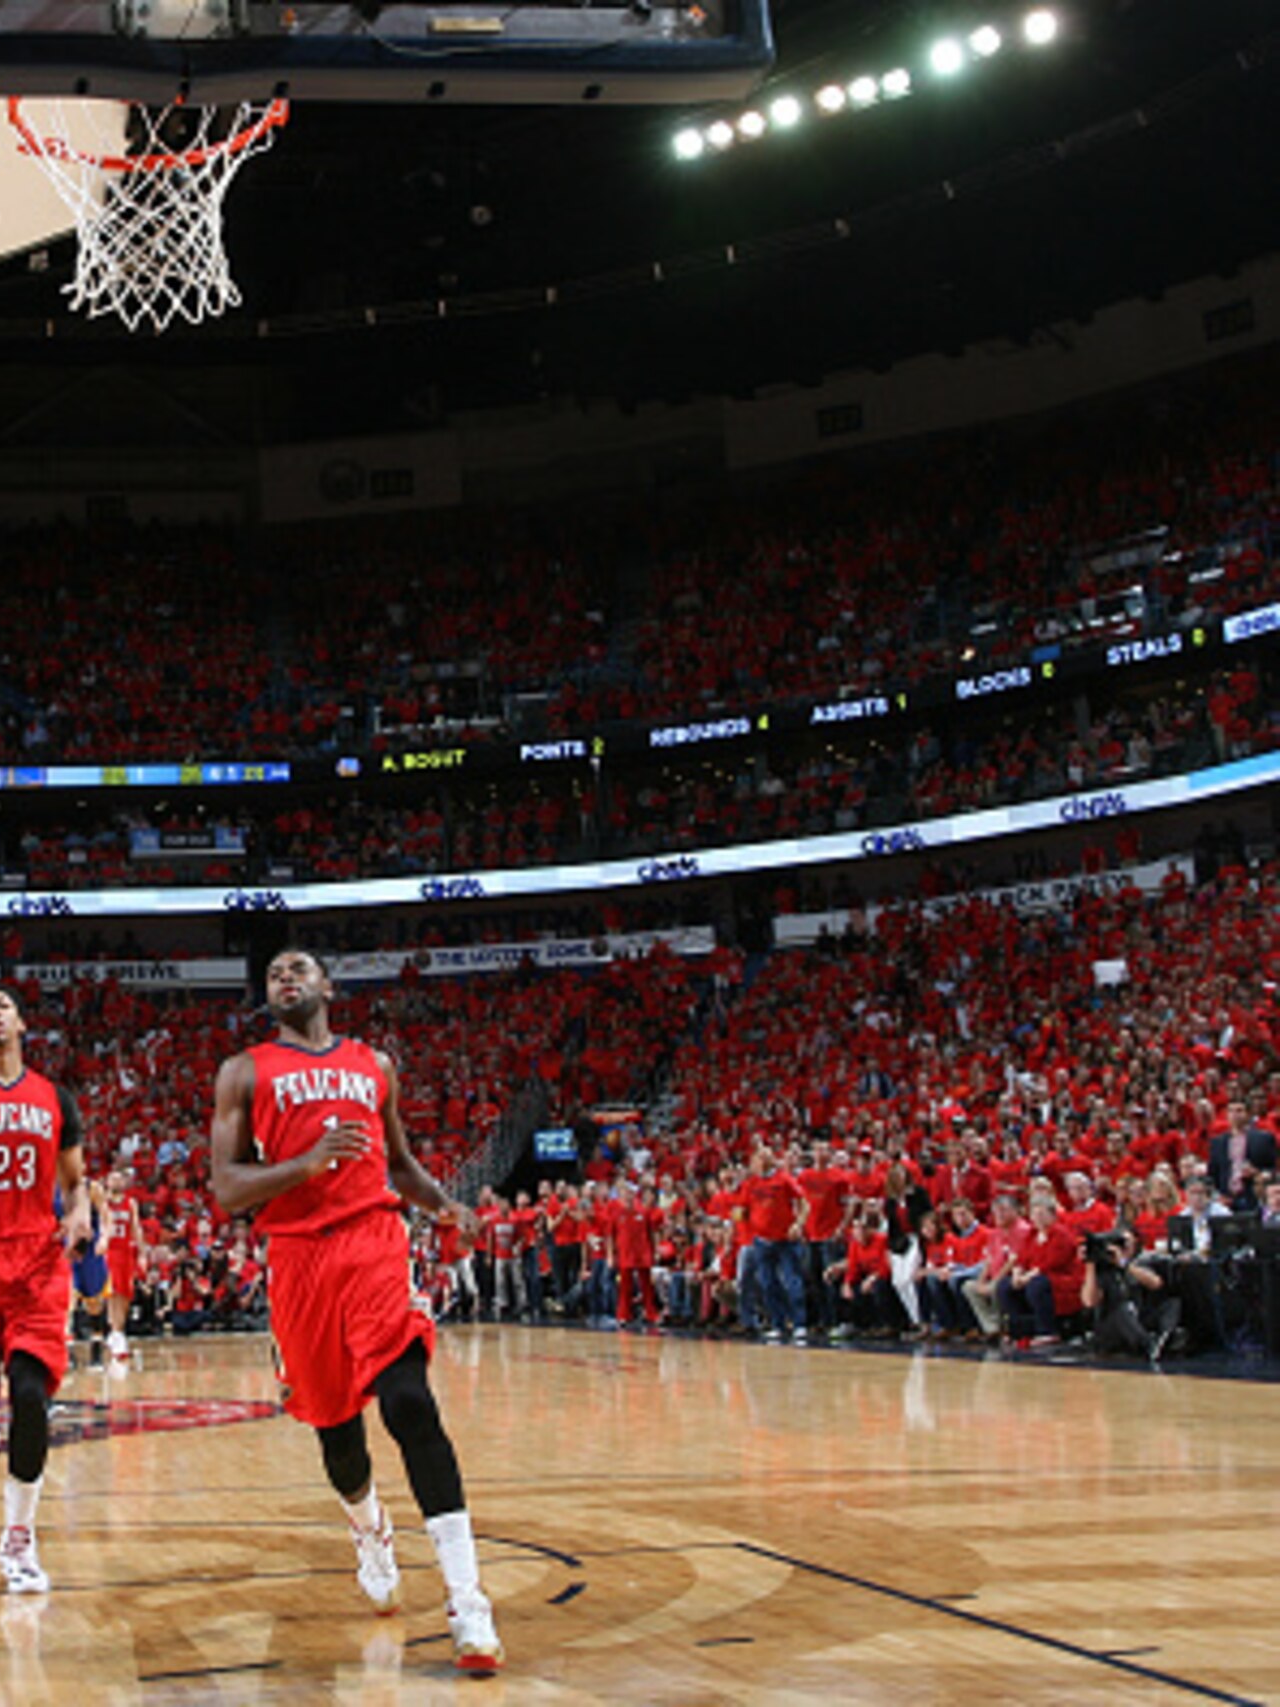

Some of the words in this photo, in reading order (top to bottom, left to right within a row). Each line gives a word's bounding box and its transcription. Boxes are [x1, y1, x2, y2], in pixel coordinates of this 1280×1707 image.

[1107, 633, 1182, 665] STEALS
[956, 667, 1031, 699] BLOCKS
[810, 698, 888, 724] ASSISTS
[650, 716, 750, 747] REBOUNDS
[521, 741, 587, 761] POINTS
[271, 1068, 378, 1113] PELICANS
